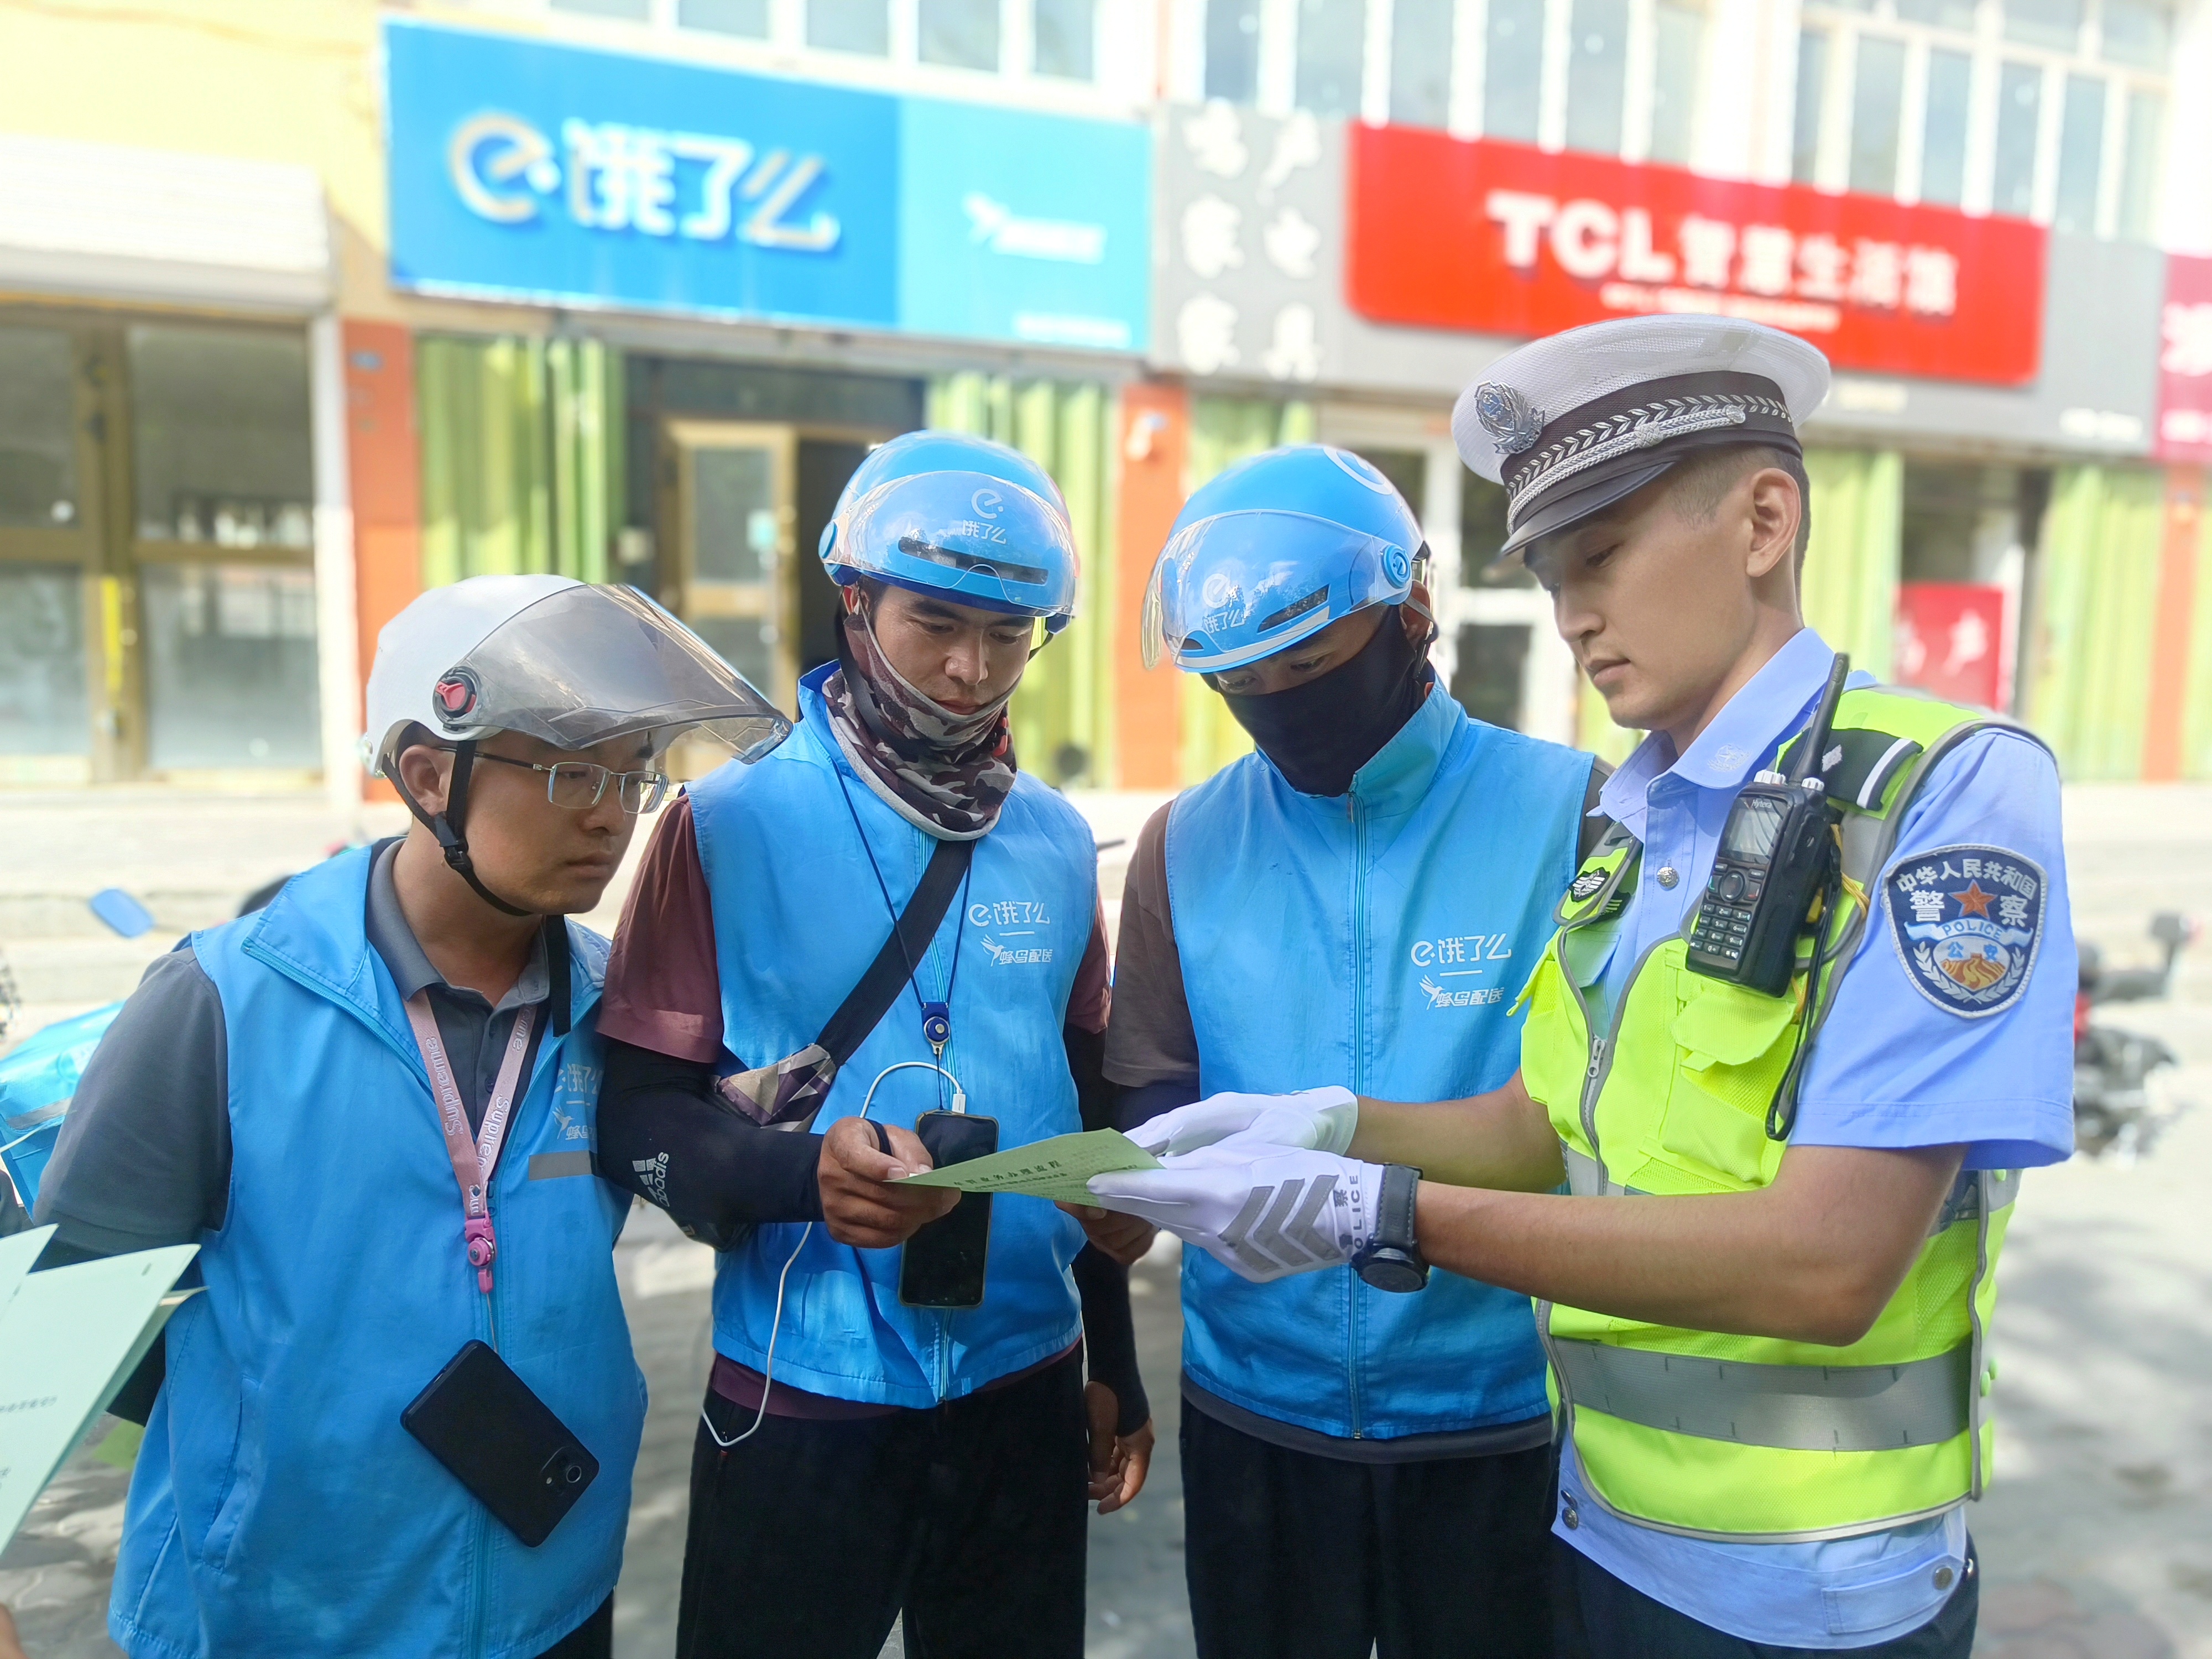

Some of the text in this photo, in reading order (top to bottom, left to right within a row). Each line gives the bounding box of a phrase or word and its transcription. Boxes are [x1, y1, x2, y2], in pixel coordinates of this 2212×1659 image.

[962, 520, 1006, 544] 饿了么
[1203, 609, 1246, 634] 饿了么
[1752, 799, 1772, 808] Hytera
[1896, 858, 2038, 900] 中华人民共和国
[1941, 920, 2004, 940] POLICE
[999, 948, 1053, 965] 蜂鸟配送
[1434, 987, 1505, 1008] 蜂鸟配送
[426, 1036, 463, 1135] Supreme
[1349, 1174, 1364, 1250] OLICE
